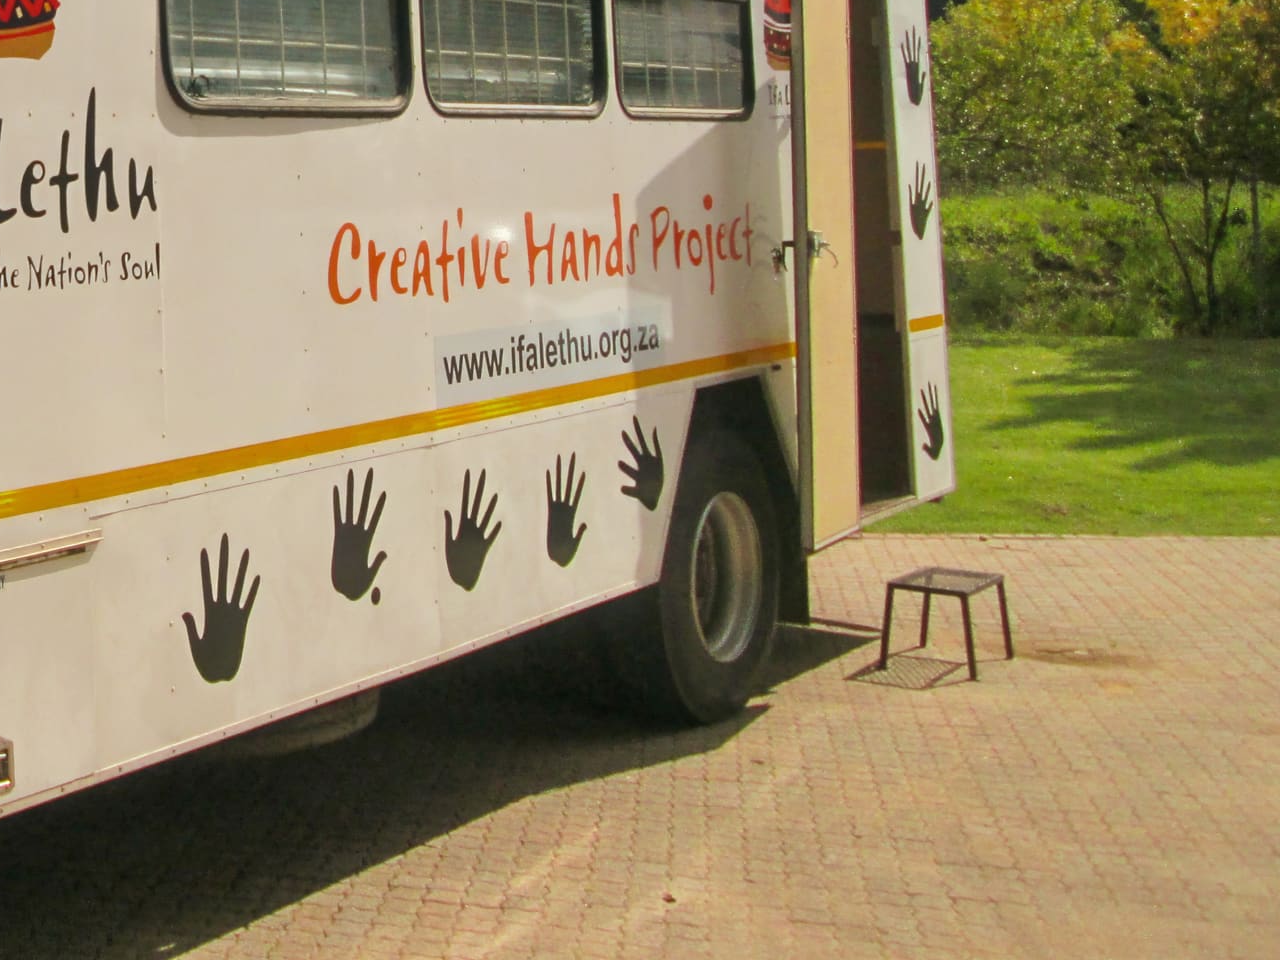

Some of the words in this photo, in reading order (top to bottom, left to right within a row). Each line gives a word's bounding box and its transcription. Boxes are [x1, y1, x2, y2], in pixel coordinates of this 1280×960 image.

[27, 251, 111, 291] Nation's
[120, 242, 161, 281] Soul
[327, 206, 510, 305] Creative
[524, 192, 639, 287] Hands
[650, 193, 754, 296] Project
[443, 322, 660, 385] www.ifalethu.org.za
